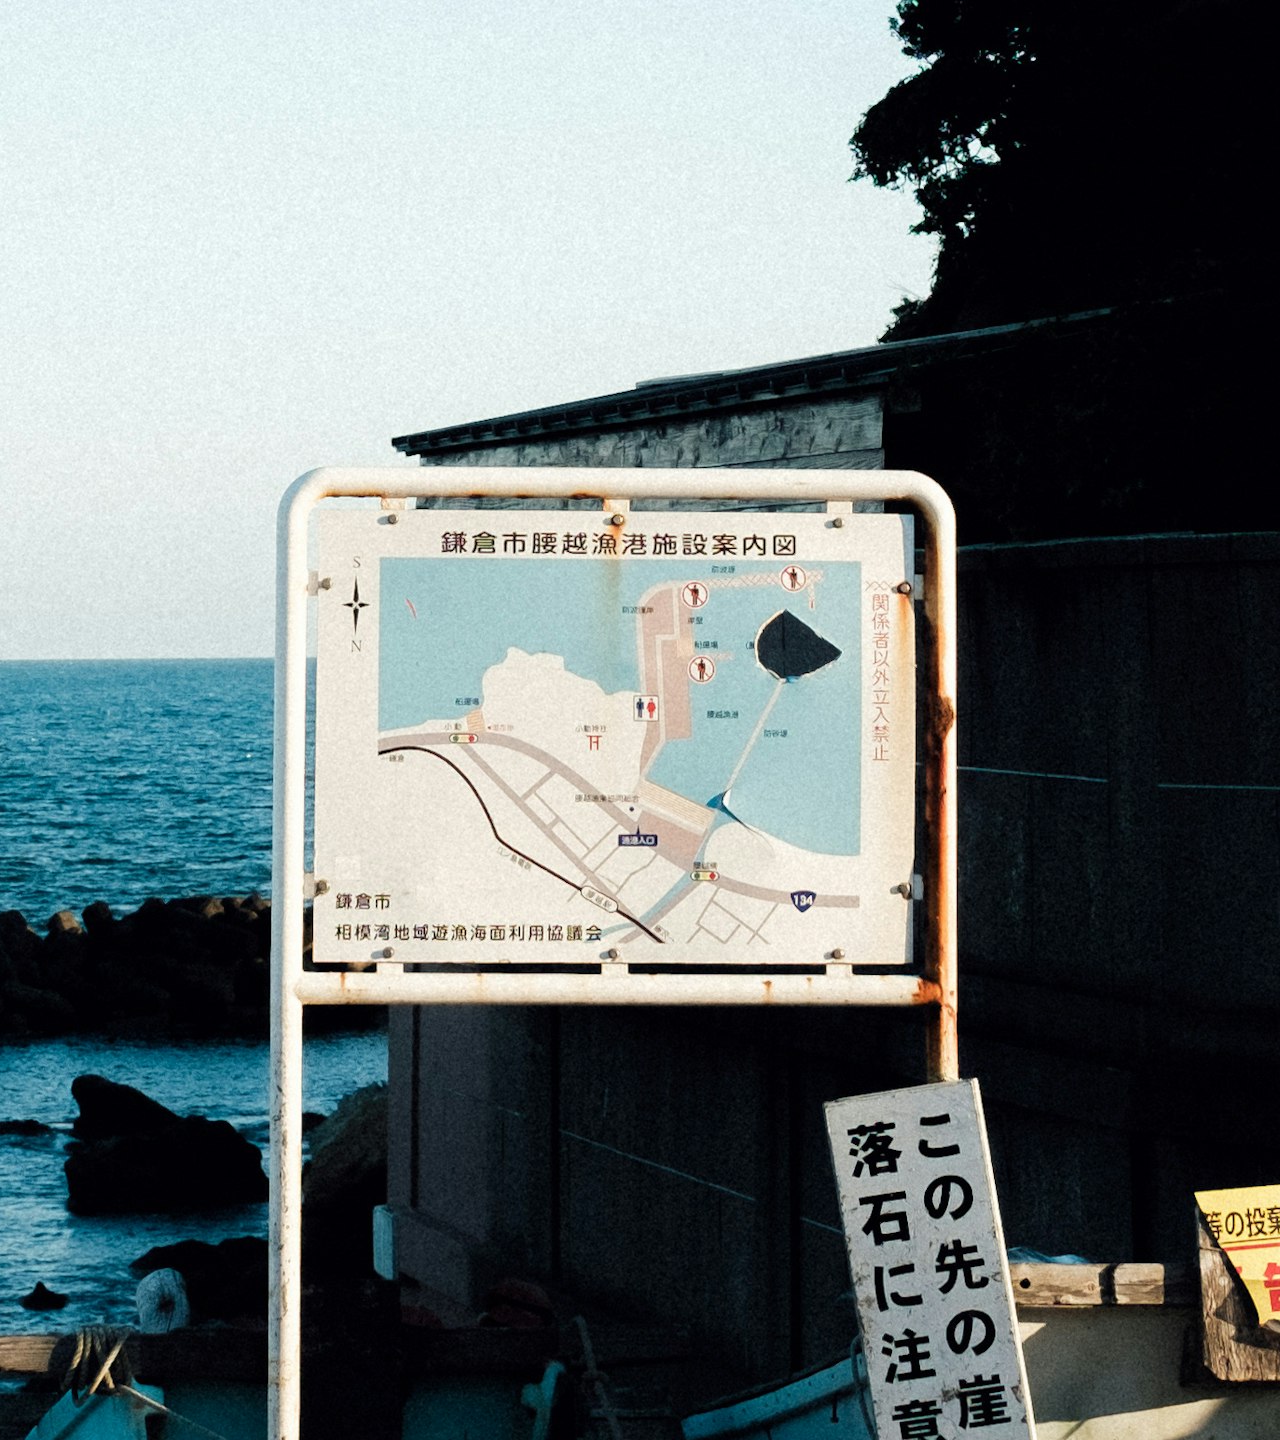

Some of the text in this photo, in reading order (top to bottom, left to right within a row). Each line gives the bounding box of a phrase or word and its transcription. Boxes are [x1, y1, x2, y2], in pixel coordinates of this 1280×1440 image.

[440, 530, 797, 557] 鎌倉市腰越漁港施設案内図
[352, 555, 362, 570] S
[351, 639, 363, 653] N
[871, 593, 891, 762] 関係者以外立入禁止
[334, 892, 391, 911] 鎌倉市
[792, 894, 814, 907] 134
[334, 923, 603, 942] 相模湾地域遊漁海面利用協議会
